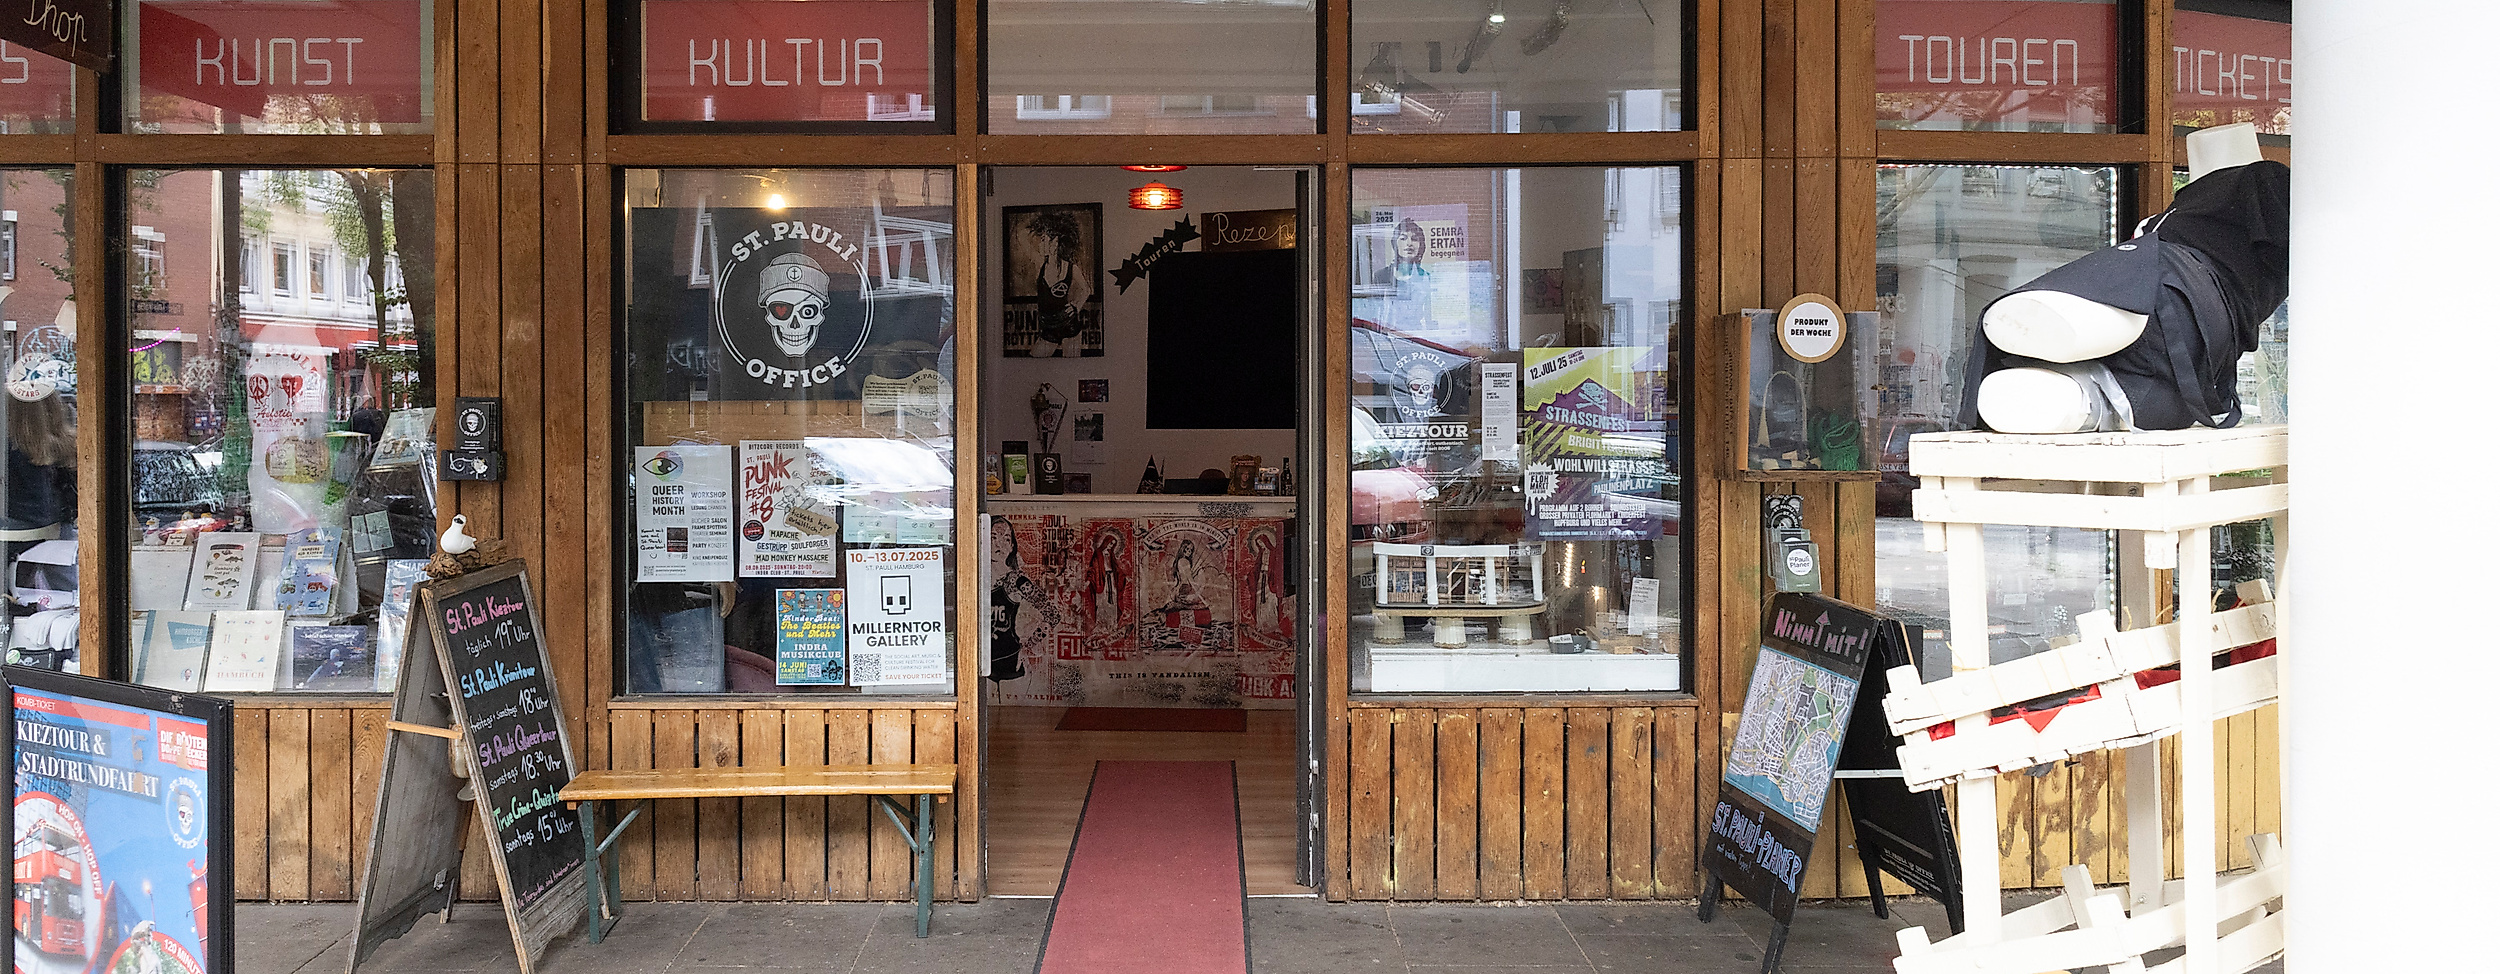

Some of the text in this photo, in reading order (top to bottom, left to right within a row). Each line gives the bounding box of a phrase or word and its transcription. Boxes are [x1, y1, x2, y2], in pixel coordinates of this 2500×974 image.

[196, 37, 364, 86] KUNST
[689, 38, 883, 86] KULTUR
[1899, 35, 2078, 85] TOUREN
[1431, 227, 1464, 237] SEMRA
[731, 220, 858, 263] ST. PAULI
[1431, 238, 1464, 248] ERTAN
[1134, 239, 1176, 271] Touren
[1431, 250, 1465, 258] begegnen
[1806, 329, 1832, 337] WOCHE
[1396, 352, 1446, 369] ST. PAULI
[1558, 356, 1568, 371] 25
[743, 355, 847, 389] OFFICE
[1402, 404, 1441, 418] OFFICE
[1546, 406, 1631, 432] STRASSENFEST
[1375, 425, 1469, 438] KIEZTOUR
[742, 450, 795, 488] PUNK
[1554, 458, 1655, 473] WOHLWILLSTRASSE
[1531, 475, 1549, 483] FLOH
[1593, 479, 1653, 494] PAULINENPLATZ
[652, 485, 684, 495] QUEER
[746, 481, 784, 501] FESTIVAL
[652, 507, 685, 515] MONTH
[749, 496, 774, 523] #8
[791, 509, 832, 530] tickets hier
[771, 531, 799, 539] MAPACHE
[791, 540, 828, 550] SOULFORGER
[486, 595, 523, 620] Kieztour
[781, 621, 841, 630] The Beatles
[852, 621, 941, 634] MILLERNTOR
[466, 635, 493, 658] täglich
[513, 626, 531, 643] Uhr
[808, 630, 836, 638] Mehr
[866, 635, 928, 647] GALLERY
[16, 696, 56, 711] KOMBI-TICKET
[496, 704, 518, 721] samstags
[536, 696, 549, 711] Uhr
[17, 721, 106, 756] KIEZTOUR &
[489, 766, 519, 791] samstags
[544, 755, 562, 772] Uhr
[494, 807, 515, 832] True
[505, 828, 535, 854] sonntags
[555, 818, 574, 834] Uhr
[58, 804, 103, 895] HOP ON HOP OFF
[164, 938, 178, 954] 120
